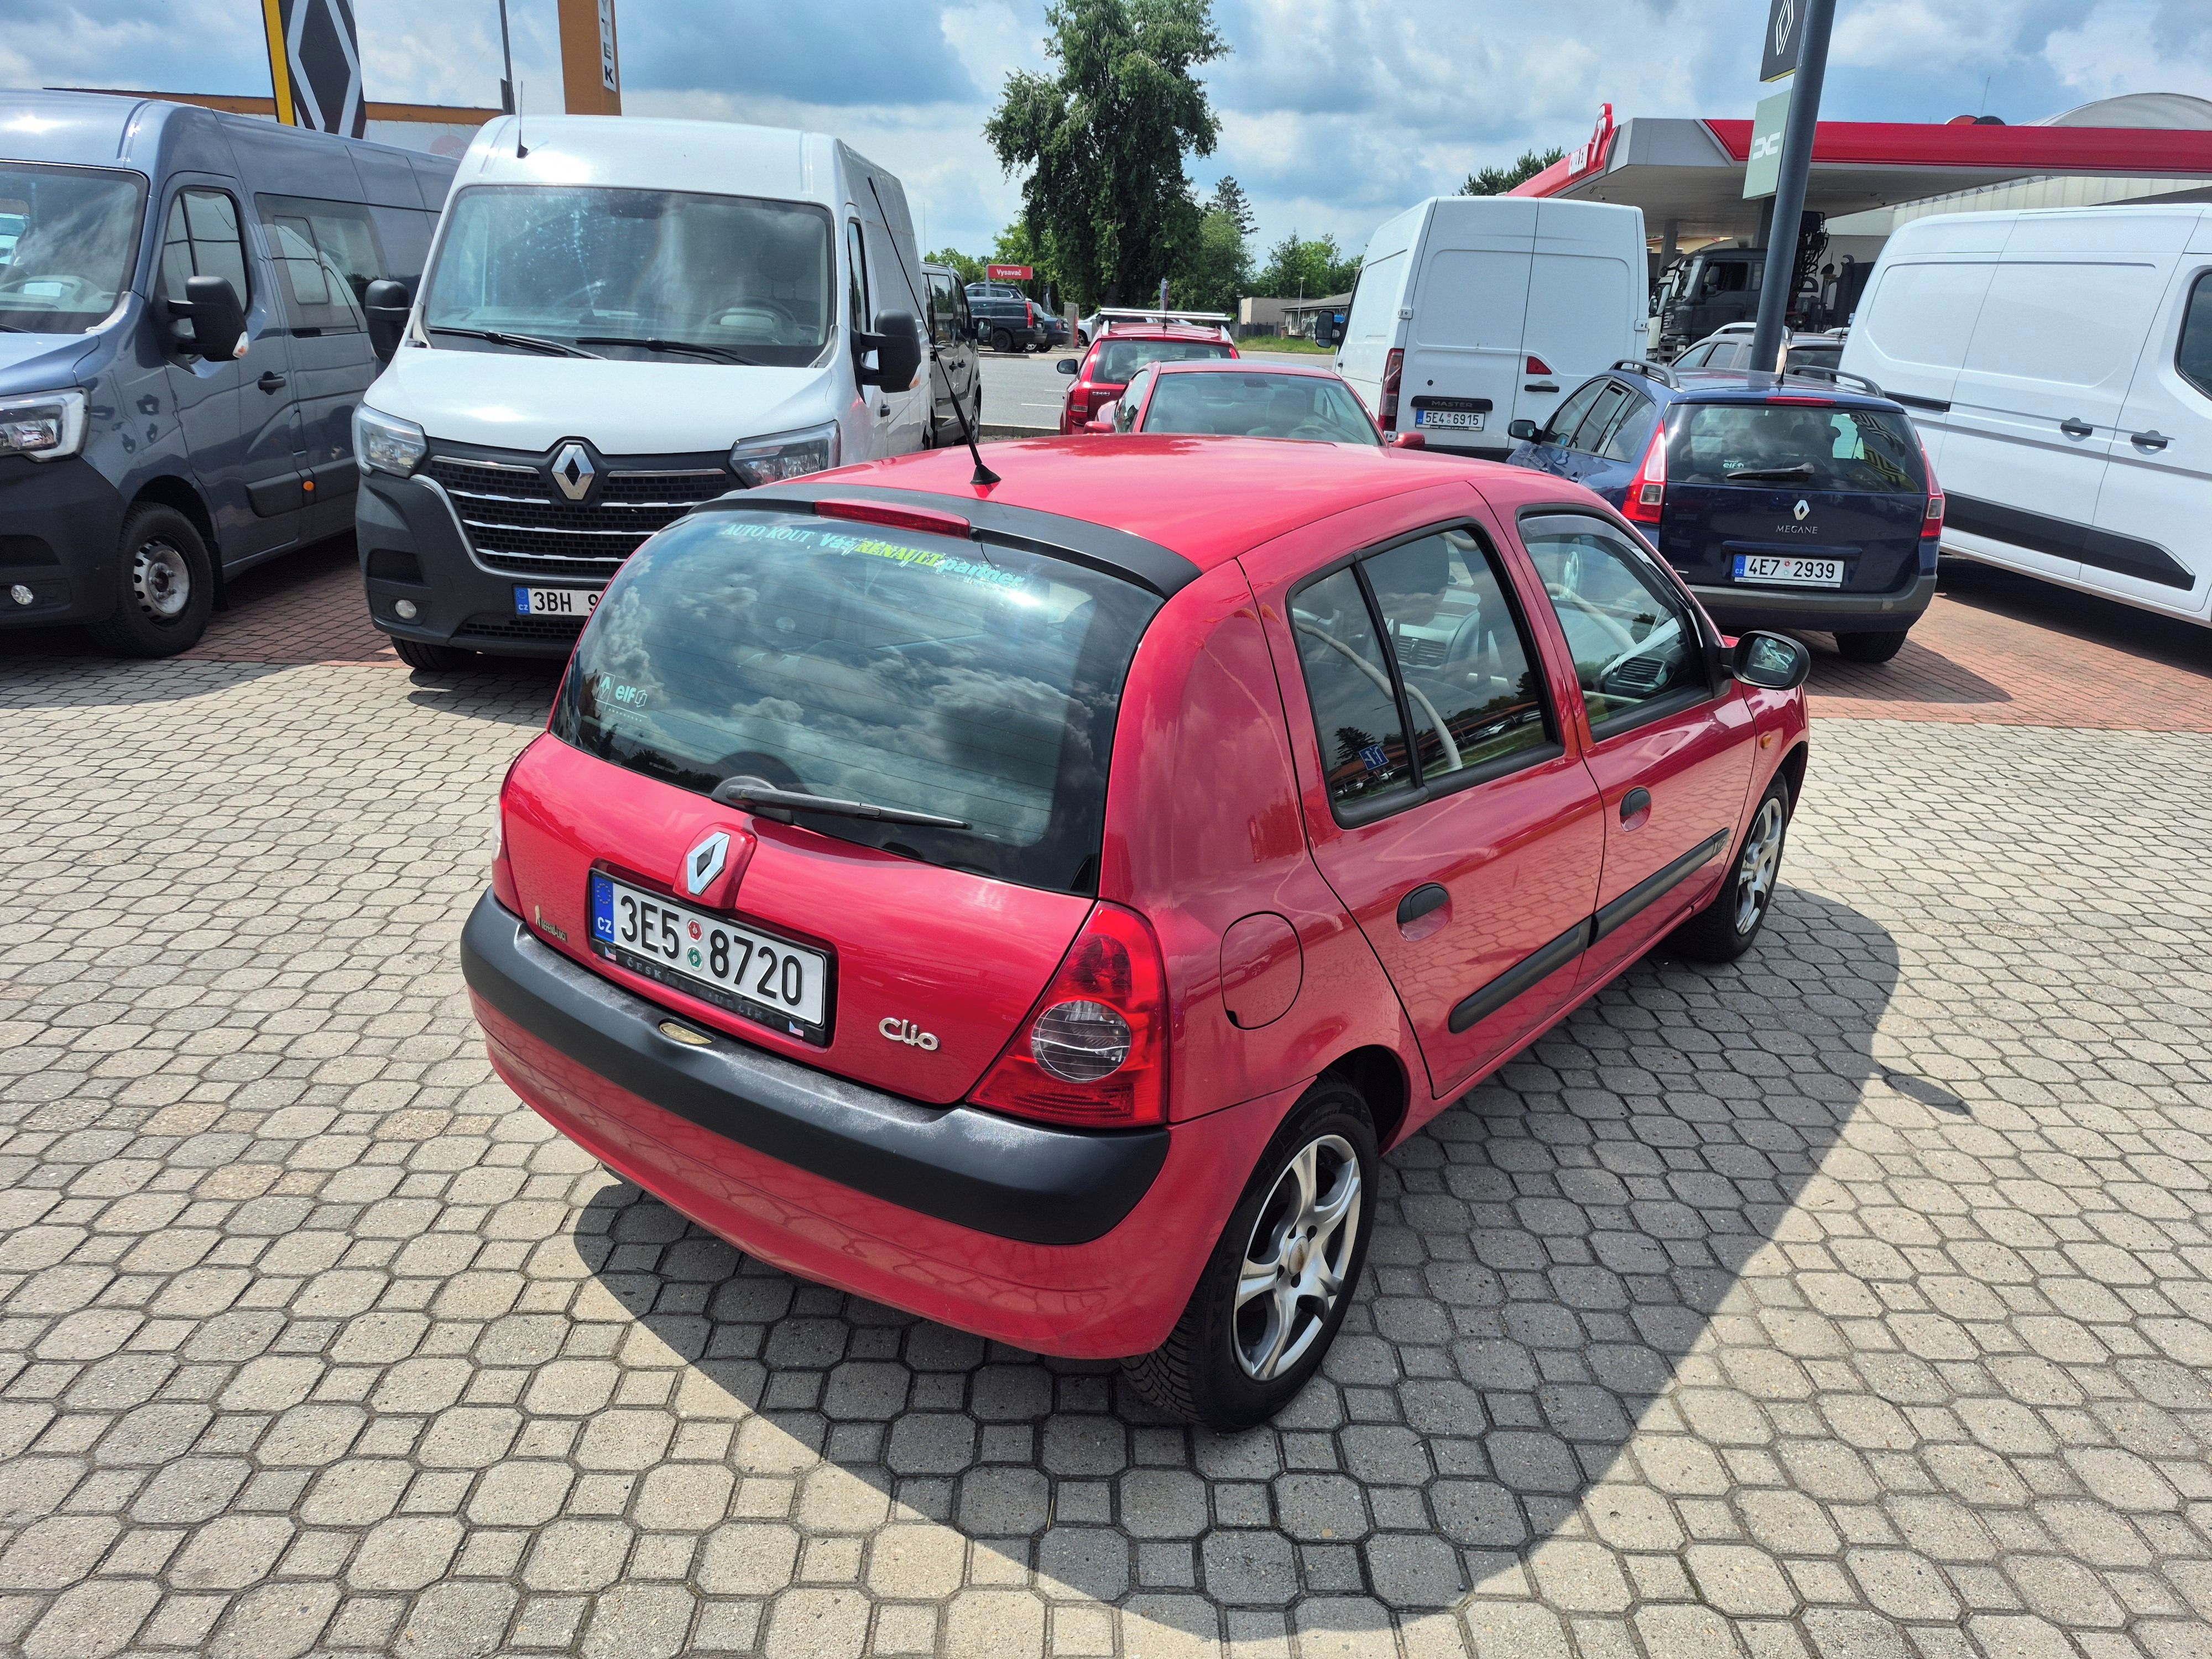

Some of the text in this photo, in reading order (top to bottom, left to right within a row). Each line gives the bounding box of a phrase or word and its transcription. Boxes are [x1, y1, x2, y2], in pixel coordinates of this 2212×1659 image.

[1426, 412, 1479, 425] 5E4 6915
[1776, 525, 1818, 534] MEGANE
[721, 524, 1025, 587] AUTO KOUT Váš RENAULT partner
[1749, 558, 1835, 579] 4E7 2939
[534, 592, 572, 612] 3BH
[615, 685, 637, 703] elf
[597, 916, 612, 934] CZ
[620, 895, 680, 959] 3E5
[709, 929, 802, 1006] 8720
